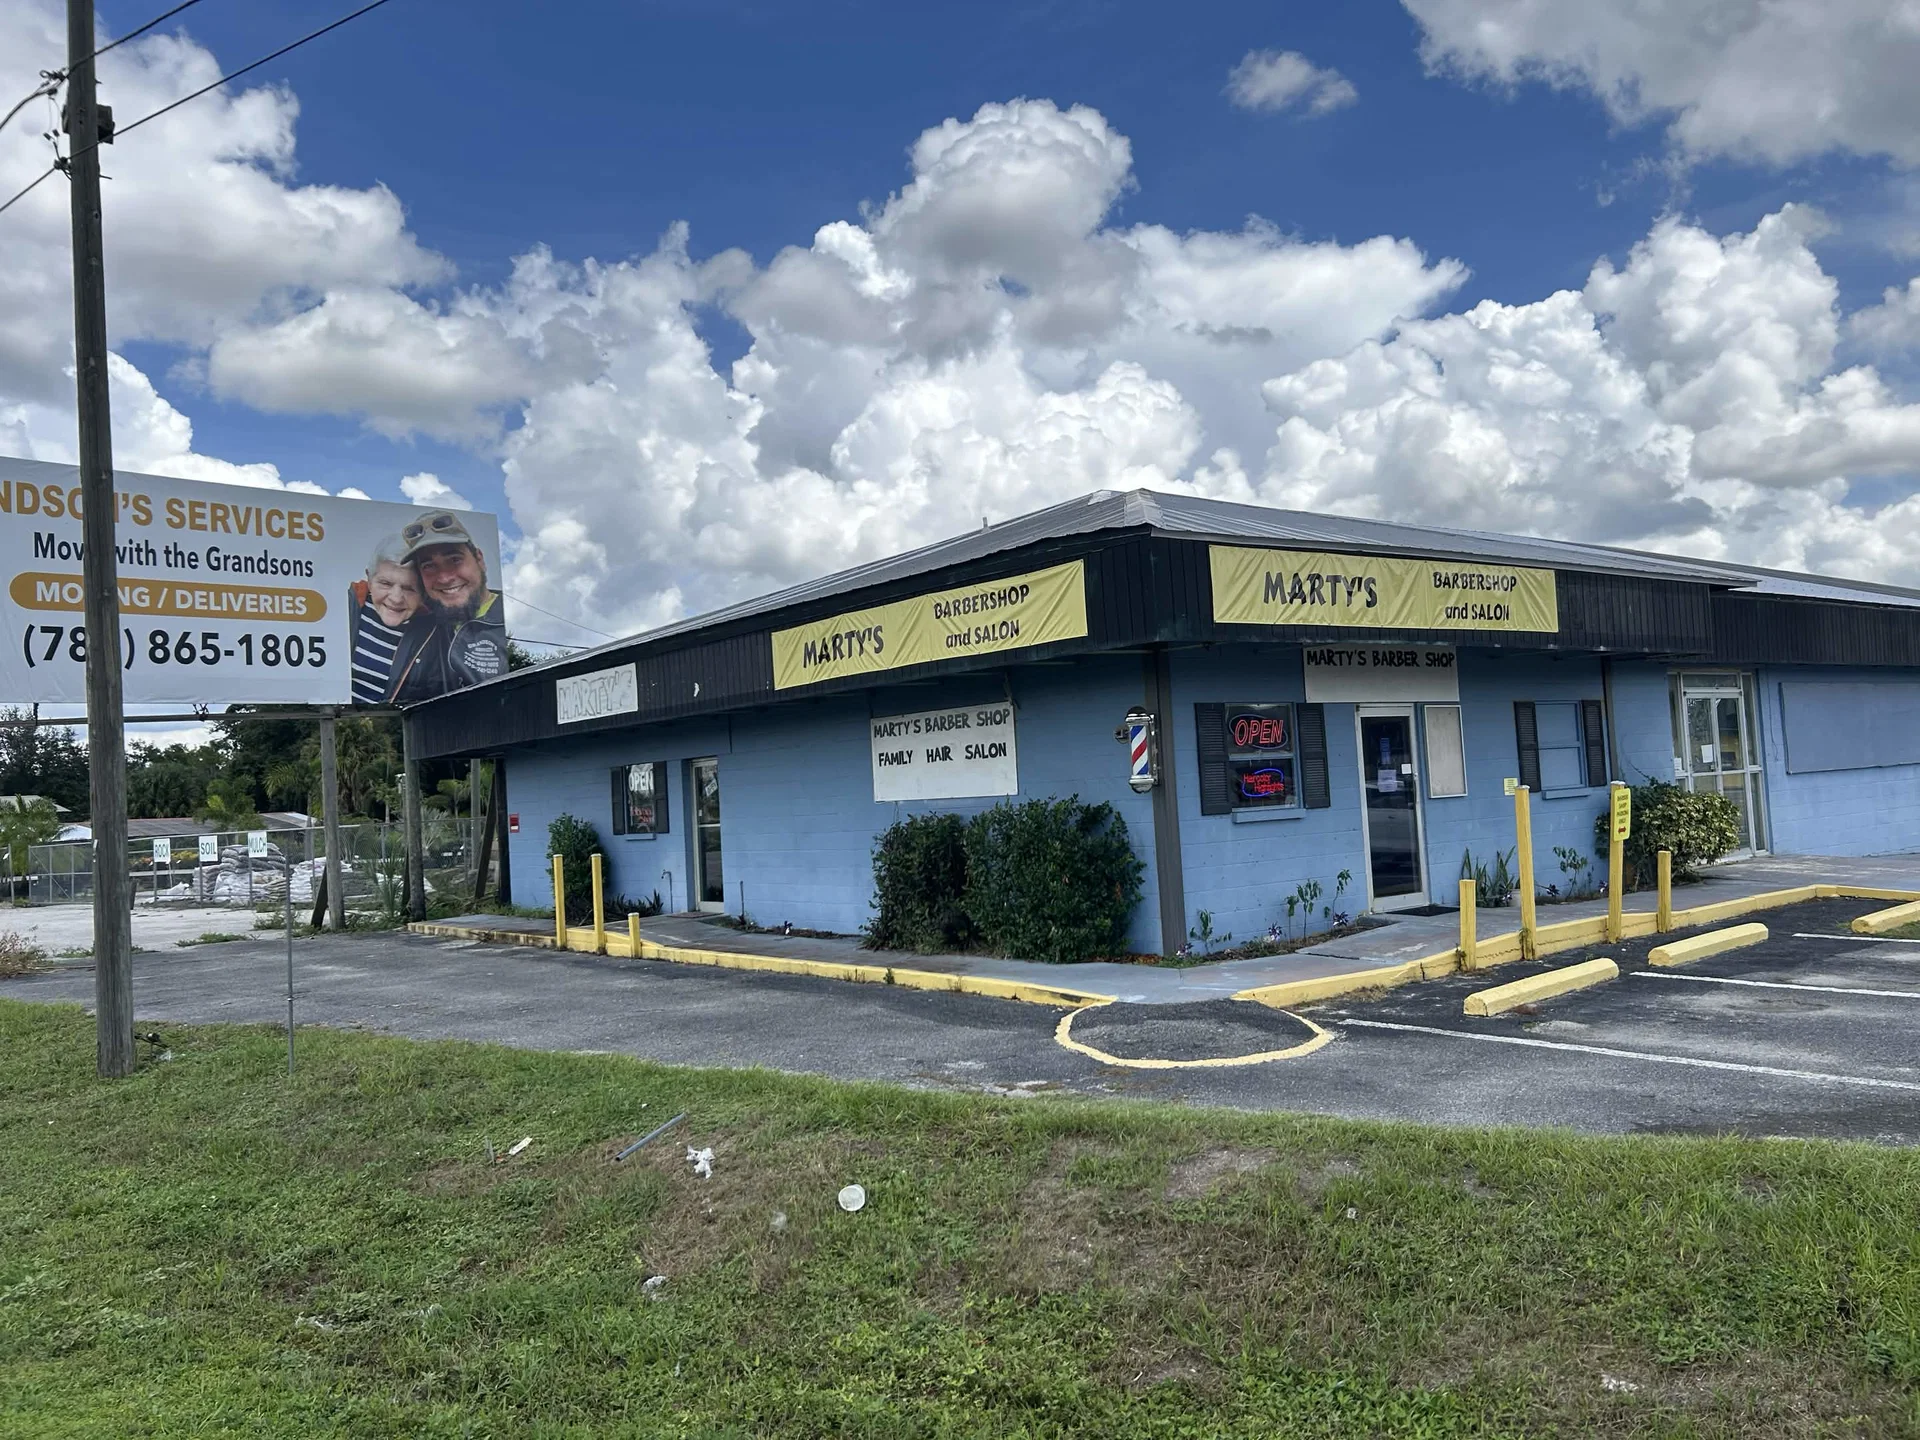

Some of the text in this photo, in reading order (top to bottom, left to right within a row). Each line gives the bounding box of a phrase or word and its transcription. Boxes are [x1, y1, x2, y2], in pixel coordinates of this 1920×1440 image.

[0, 481, 325, 542] DSO'S SERVICES
[34, 531, 84, 561] Mov
[163, 542, 199, 570] the
[206, 546, 314, 578] Grandsons
[36, 581, 150, 608] MONG
[175, 589, 308, 616] DELIVERIES
[1263, 571, 1517, 608] MARTY'S BARBERSHOP
[803, 584, 1030, 669] MARTY'S BARBERSHOP
[1445, 602, 1510, 621] and SALON
[23, 623, 327, 670] (78) 865-1805
[945, 619, 1020, 649] and SALON
[1306, 649, 1456, 668] MARTY'S BARBER SHOP
[874, 708, 1011, 738] MARTY'S BARBER SHOP
[1234, 719, 1284, 746] OPEN
[878, 742, 1008, 767] FAMILY HAIR SALON
[628, 770, 654, 792] OPEN
[200, 841, 217, 855] SOIL
